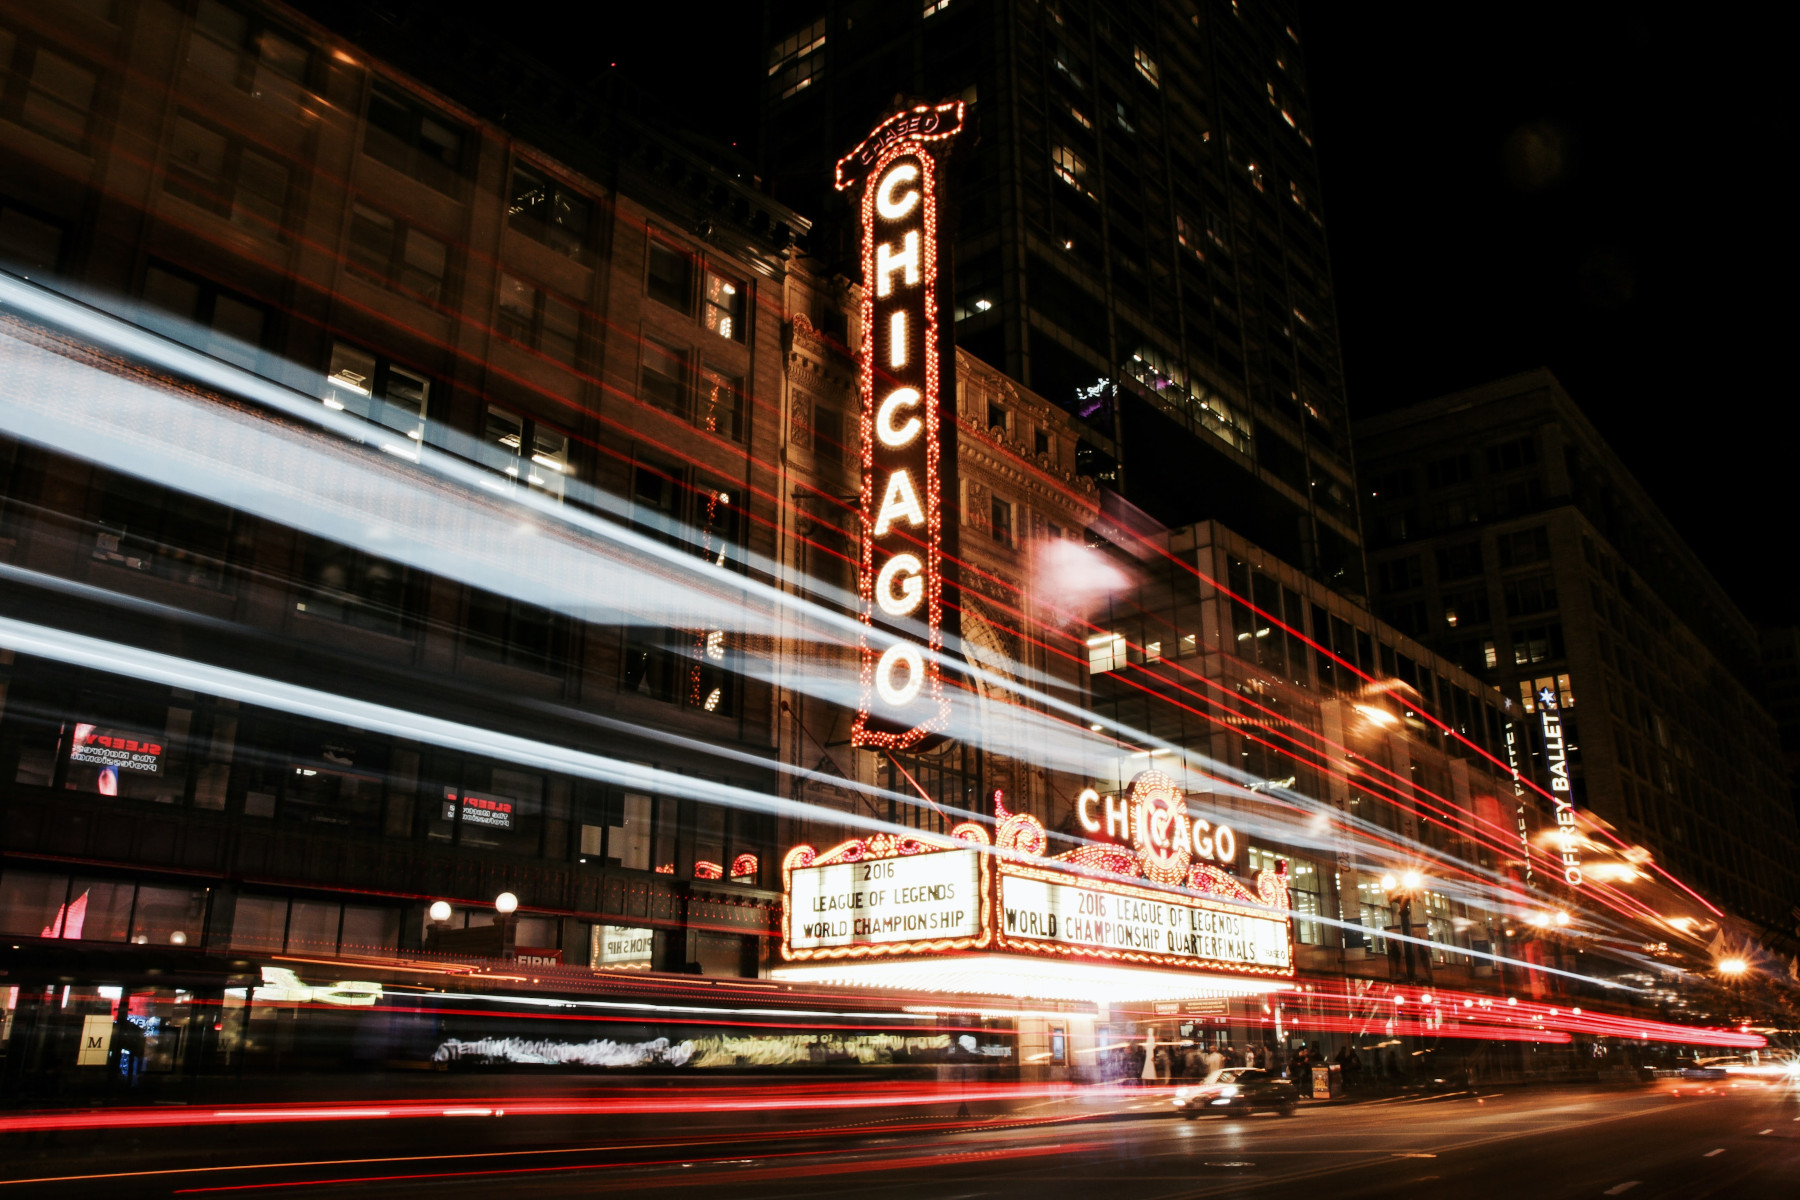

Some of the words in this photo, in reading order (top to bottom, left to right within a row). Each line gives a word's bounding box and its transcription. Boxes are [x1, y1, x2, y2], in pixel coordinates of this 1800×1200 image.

[874, 163, 926, 708] CHICAGO
[1543, 712, 1570, 792] BALLET
[1077, 788, 1236, 863] CHICAGO
[864, 862, 895, 881] 2016
[812, 891, 863, 912] LEAGUE
[869, 890, 886, 907] OF
[894, 883, 955, 905] LEGENDS
[1078, 892, 1107, 917] 2016
[1116, 898, 1164, 925] LEAGUE
[1169, 907, 1183, 927] OF
[1190, 910, 1240, 936] LEGENDS
[803, 920, 847, 939] WORLD
[853, 910, 965, 936] CHAMPIONSHIP
[1005, 907, 1058, 938] WORLD
[1065, 916, 1160, 950] CHAMPIONSHIP
[1167, 930, 1256, 960] QUARTERFINALS
[517, 955, 557, 968] FIRM
[87, 1036, 103, 1049] M
